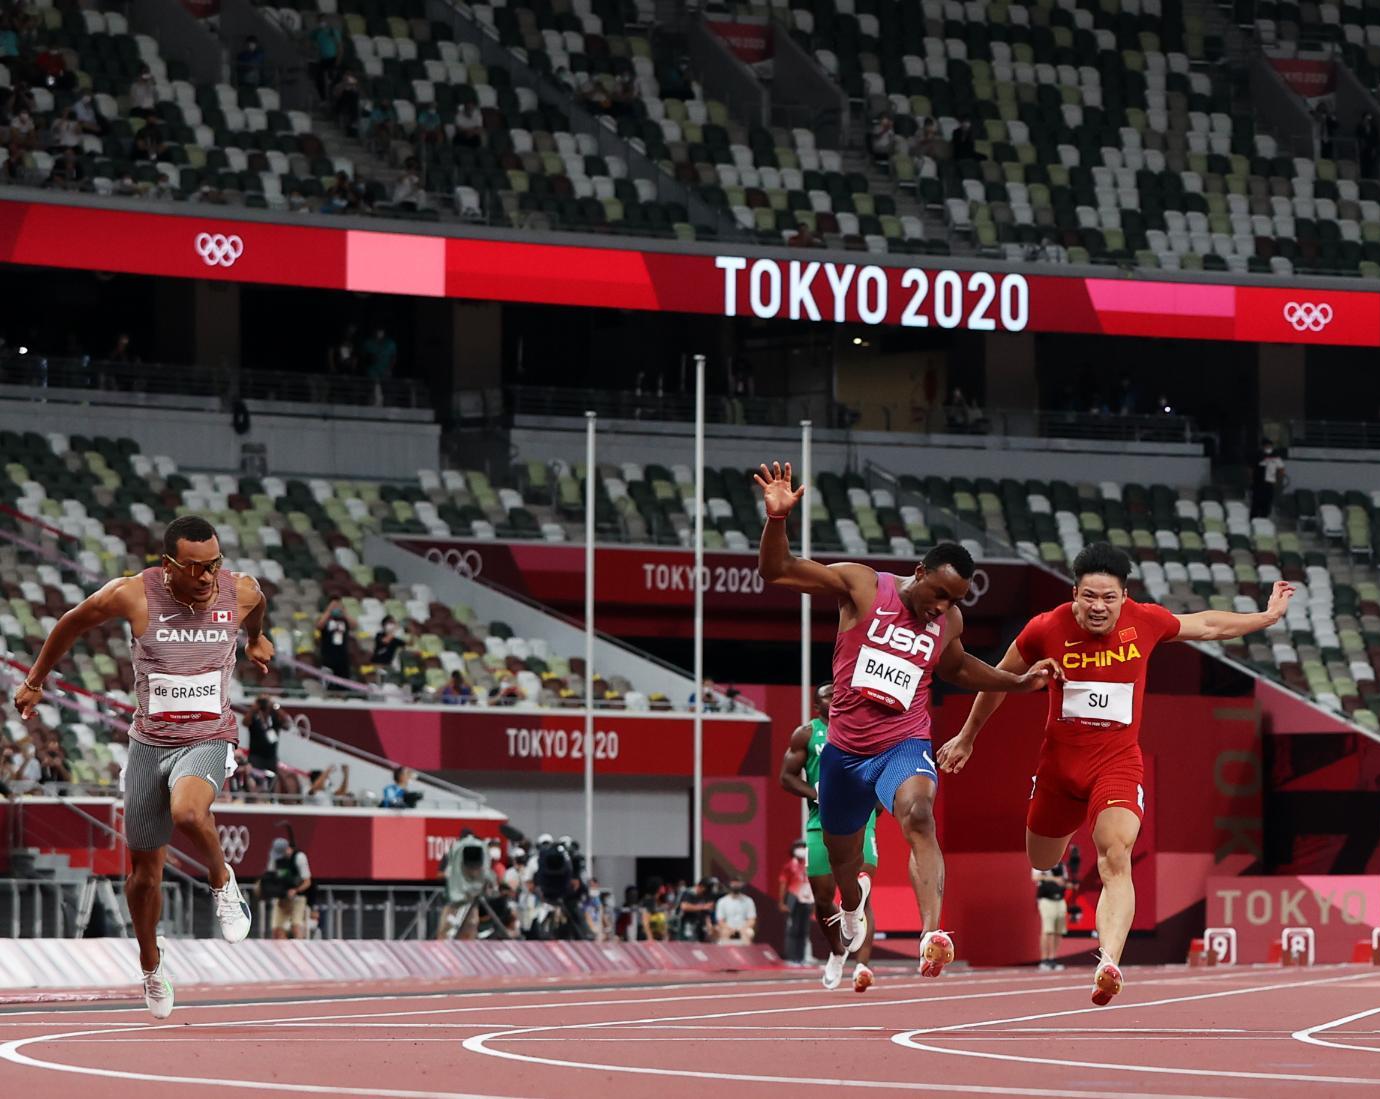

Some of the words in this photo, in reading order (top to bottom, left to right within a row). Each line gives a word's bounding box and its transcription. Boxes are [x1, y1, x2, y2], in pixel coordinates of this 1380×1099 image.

[715, 256, 888, 324] TOKYO
[901, 268, 1029, 332] 2020
[643, 563, 711, 592] TOKYO
[715, 567, 764, 594] 2020
[156, 629, 229, 642] CANADA
[867, 618, 934, 662] USA
[1063, 643, 1141, 668] CHINA
[865, 659, 911, 690] BAKER
[154, 685, 168, 697] de
[171, 684, 216, 698] GRASSE
[1088, 693, 1109, 708] SU
[506, 728, 567, 758] TOKYO
[570, 730, 618, 759] 220
[1217, 890, 1366, 926] TOKYO
[1212, 936, 1228, 961] 9
